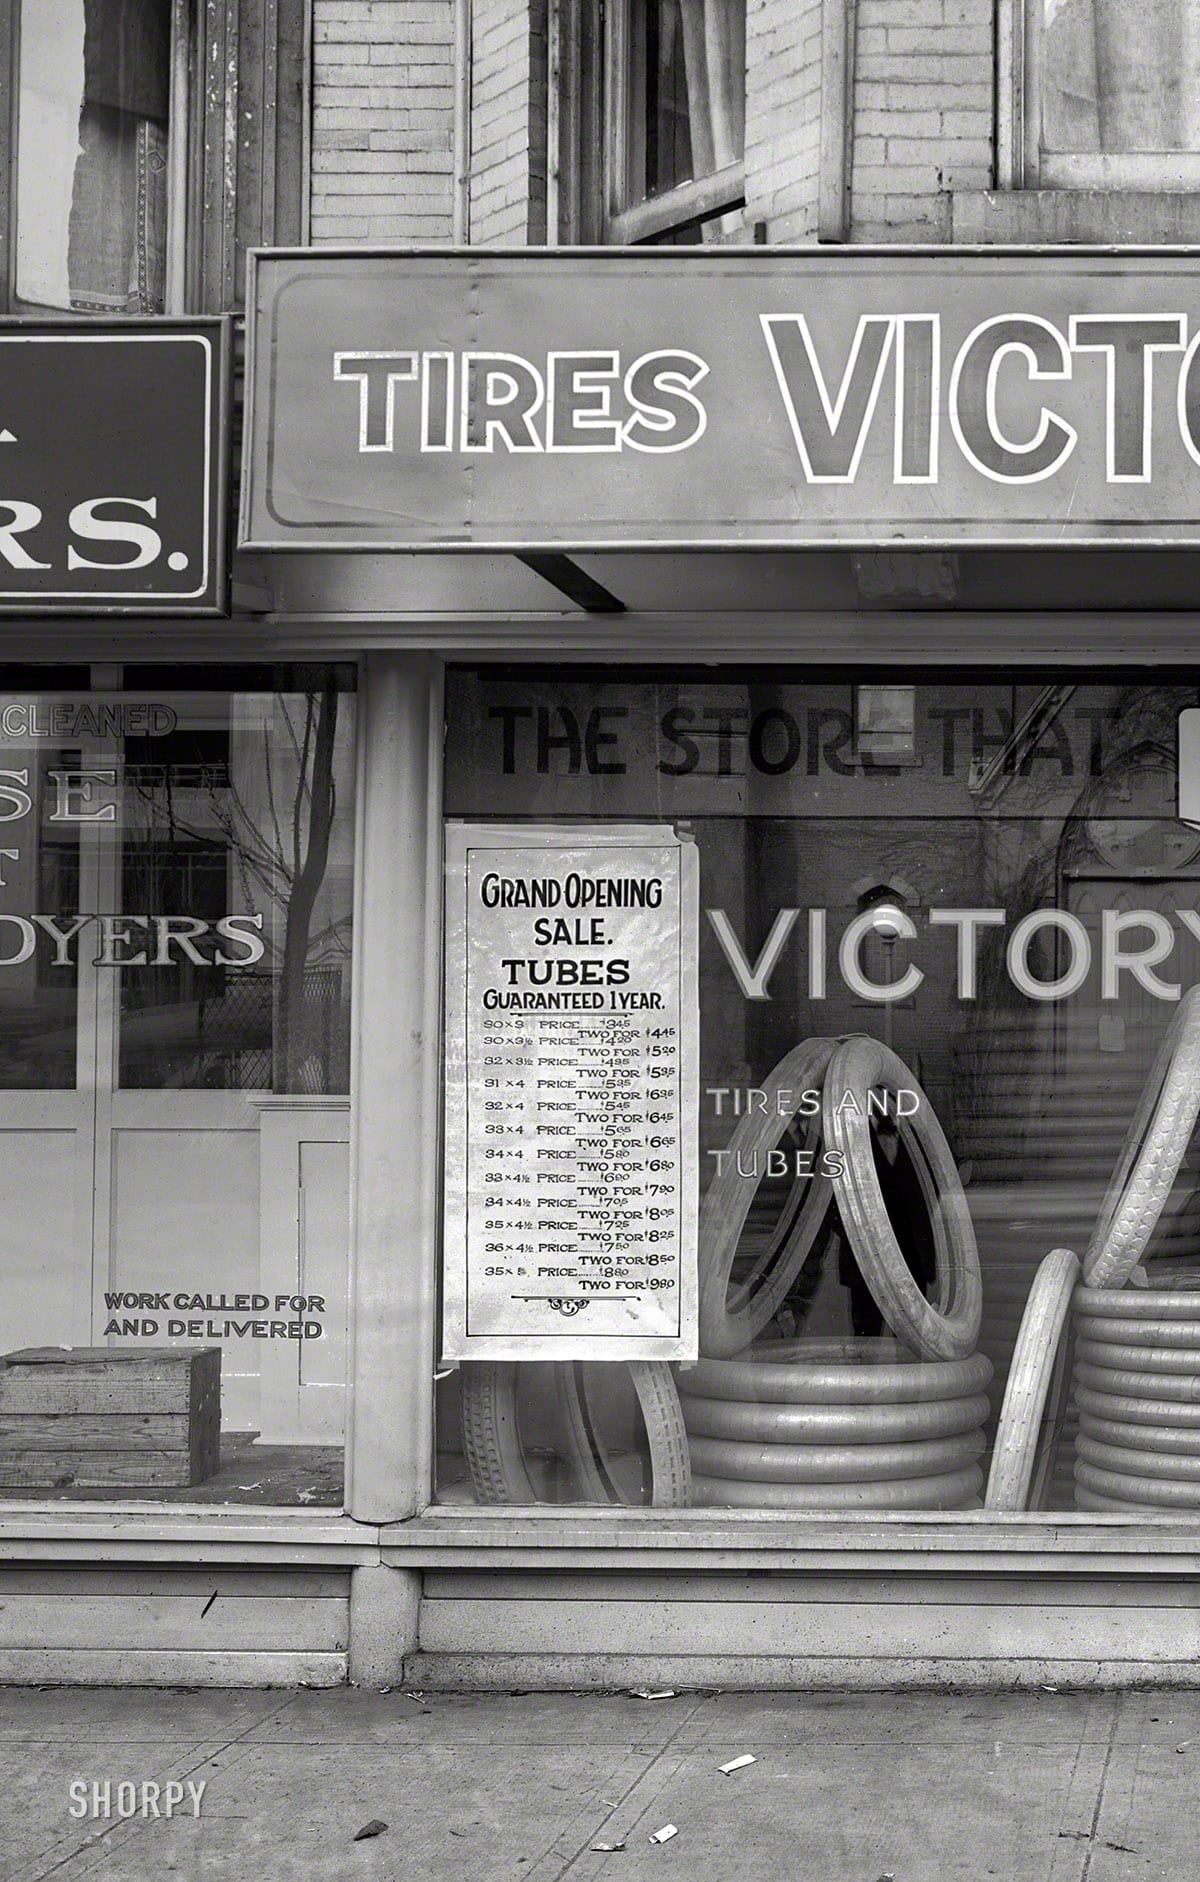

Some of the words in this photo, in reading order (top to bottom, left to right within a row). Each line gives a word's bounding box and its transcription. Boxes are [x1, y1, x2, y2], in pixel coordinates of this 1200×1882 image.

[334, 350, 710, 453] TIRES
[1, 703, 177, 738] CLEANED
[489, 706, 629, 775] THE
[927, 706, 1122, 777] THAT
[481, 873, 562, 908] GRAND
[565, 873, 662, 908] OPENING
[534, 918, 614, 945] SALE.
[501, 959, 630, 986] TUBES
[483, 989, 604, 1010] GUARANTEED
[610, 990, 616, 1009] 1
[617, 992, 666, 1010] YEAR.
[539, 1021, 580, 1029] PRICE
[577, 1030, 610, 1038] TWO
[613, 1030, 640, 1038] FOR
[539, 1037, 579, 1045] PRICE
[577, 1048, 610, 1057] TWO
[613, 1049, 640, 1057] FOR
[537, 1058, 578, 1066] PRICE
[576, 1070, 610, 1078] TWO
[613, 1069, 640, 1078] FOR
[537, 1080, 576, 1088] PRICE
[575, 1091, 610, 1100] TWO
[613, 1091, 641, 1100] FOR
[705, 1087, 820, 1116] TIRES
[836, 1088, 921, 1116] AND
[537, 1102, 576, 1111] PRICE
[574, 1112, 610, 1123] TWO
[613, 1114, 643, 1123] FOR
[536, 1126, 576, 1135] PRICE
[575, 1139, 608, 1148] TWO
[613, 1139, 643, 1148] FOR
[537, 1150, 576, 1159] PRICE
[576, 1162, 609, 1171] TWO
[613, 1163, 644, 1171] FOR
[706, 1149, 846, 1179] TUBES
[537, 1174, 576, 1183] PRICE
[576, 1187, 608, 1196] TWO
[613, 1187, 643, 1196] FOR
[537, 1199, 577, 1208] PRICE
[577, 1211, 610, 1219] TWO
[613, 1211, 643, 1219] FOR
[537, 1221, 578, 1230] PRICE
[577, 1233, 611, 1241] TWO
[616, 1233, 644, 1242] FOR
[538, 1243, 578, 1253] PRICE
[578, 1256, 612, 1265] TWO
[616, 1257, 646, 1265] FOR
[537, 1268, 578, 1277] PRICE
[578, 1281, 611, 1290] TWO
[615, 1281, 646, 1290] FOR
[103, 1292, 171, 1311] WORK
[173, 1293, 270, 1312] CALLED
[274, 1294, 325, 1313] FOR
[103, 1318, 159, 1337] AND
[167, 1319, 323, 1339] DELIVERED
